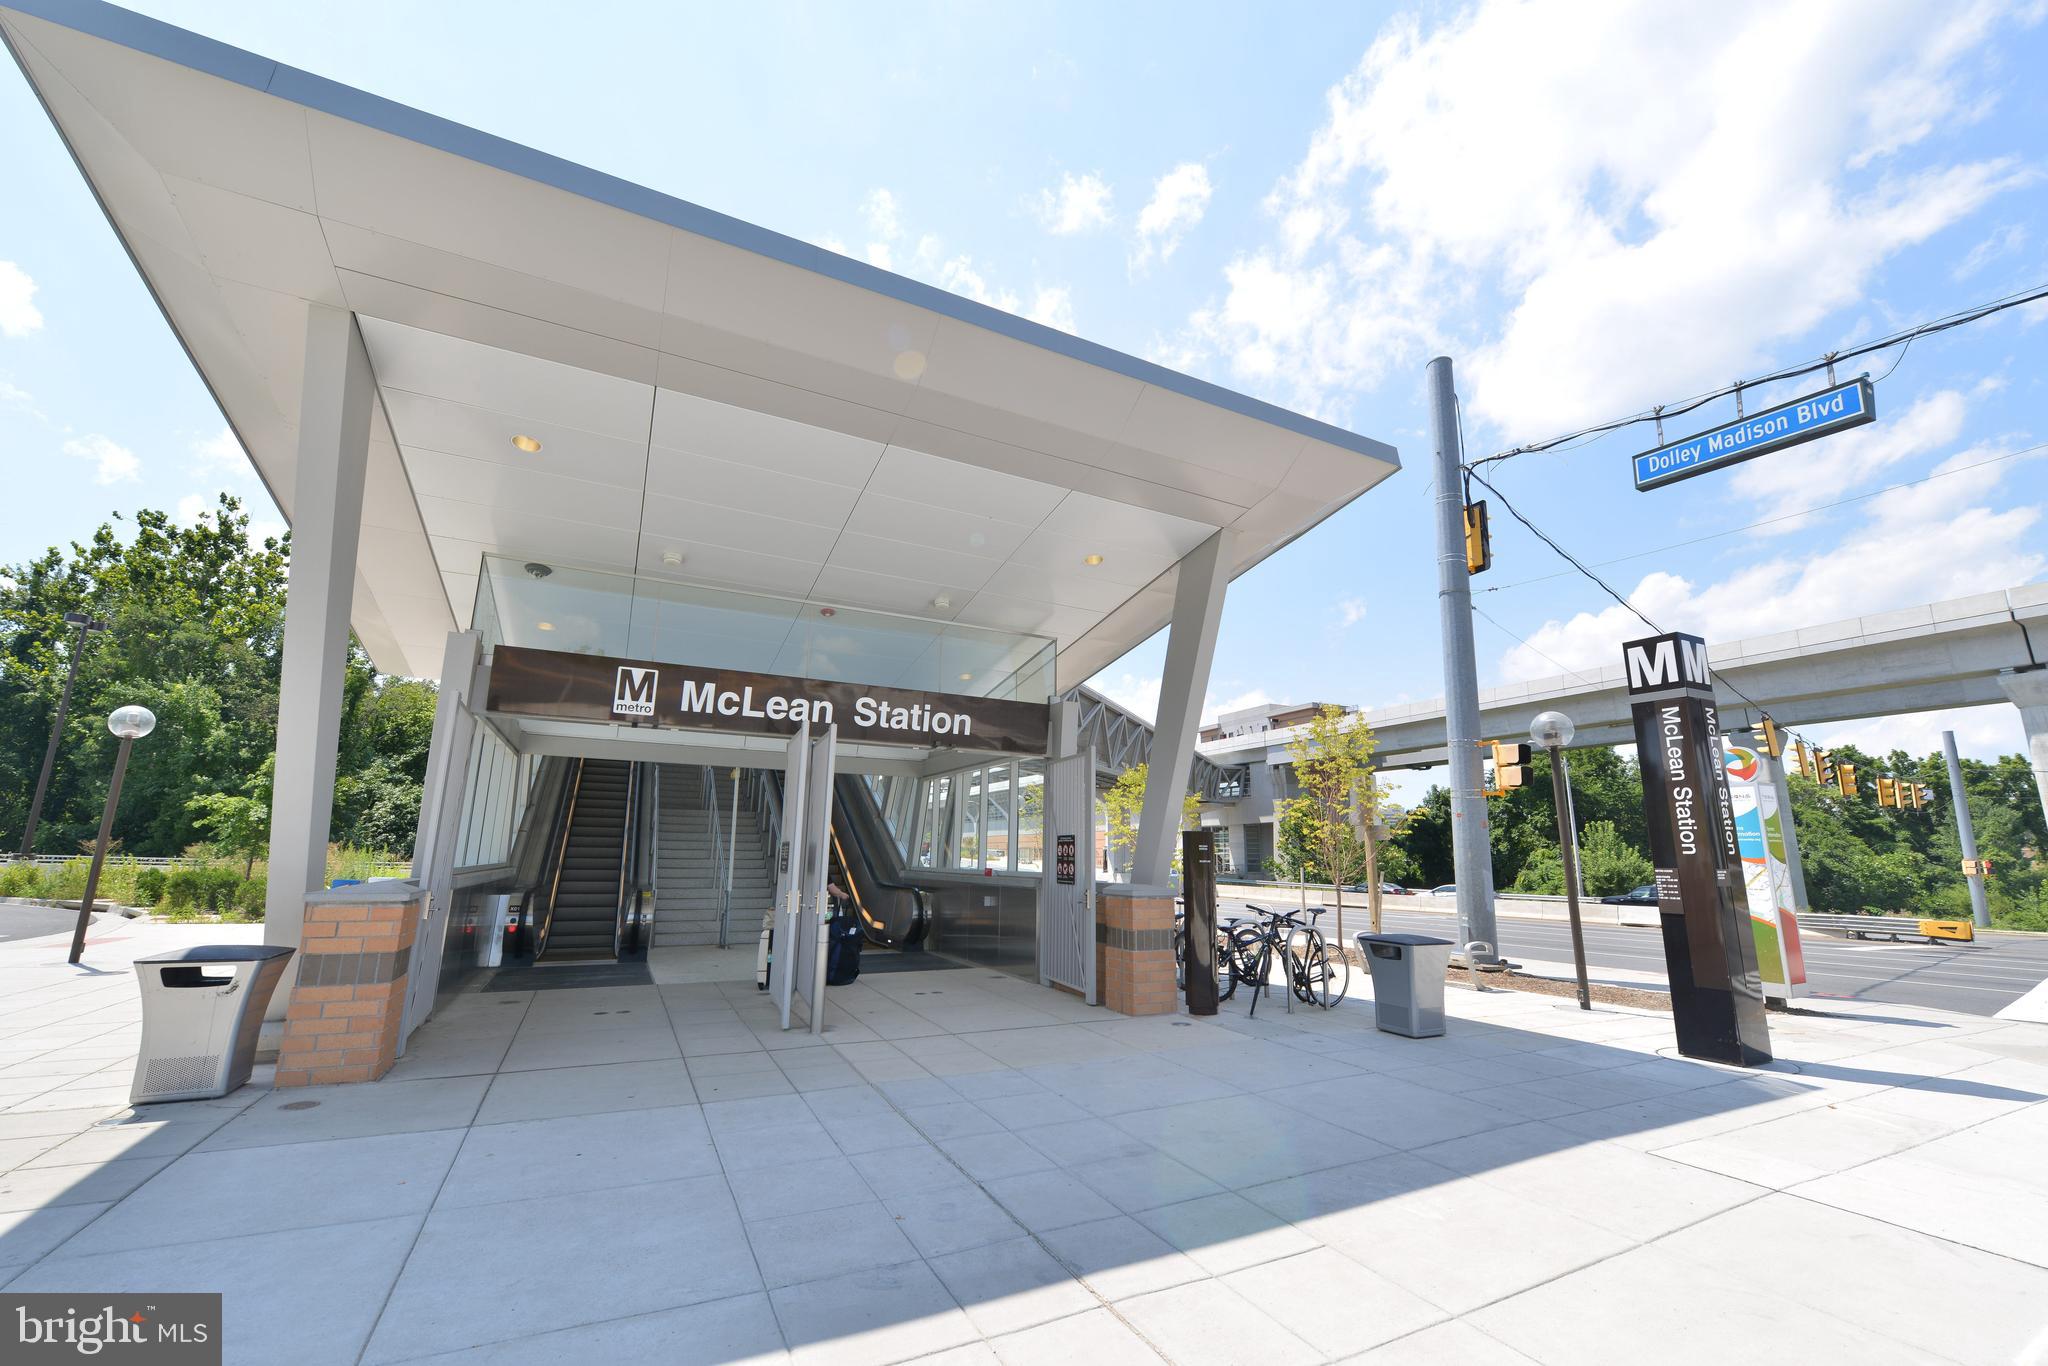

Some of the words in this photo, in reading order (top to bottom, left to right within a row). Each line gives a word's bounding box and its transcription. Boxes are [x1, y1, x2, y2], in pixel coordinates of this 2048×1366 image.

[1648, 444, 1701, 473] Dolley
[1708, 415, 1788, 453] Madison
[1797, 393, 1844, 424] Blvd
[617, 668, 656, 703] M
[1627, 640, 1680, 688] M
[1681, 640, 1711, 685] M
[616, 703, 652, 713] metro
[680, 680, 834, 724] McLean
[853, 697, 972, 735] Station
[1661, 706, 1686, 781] McLean
[1704, 707, 1723, 781] McLean
[1718, 787, 1736, 855] Station
[1673, 786, 1698, 855] Station
